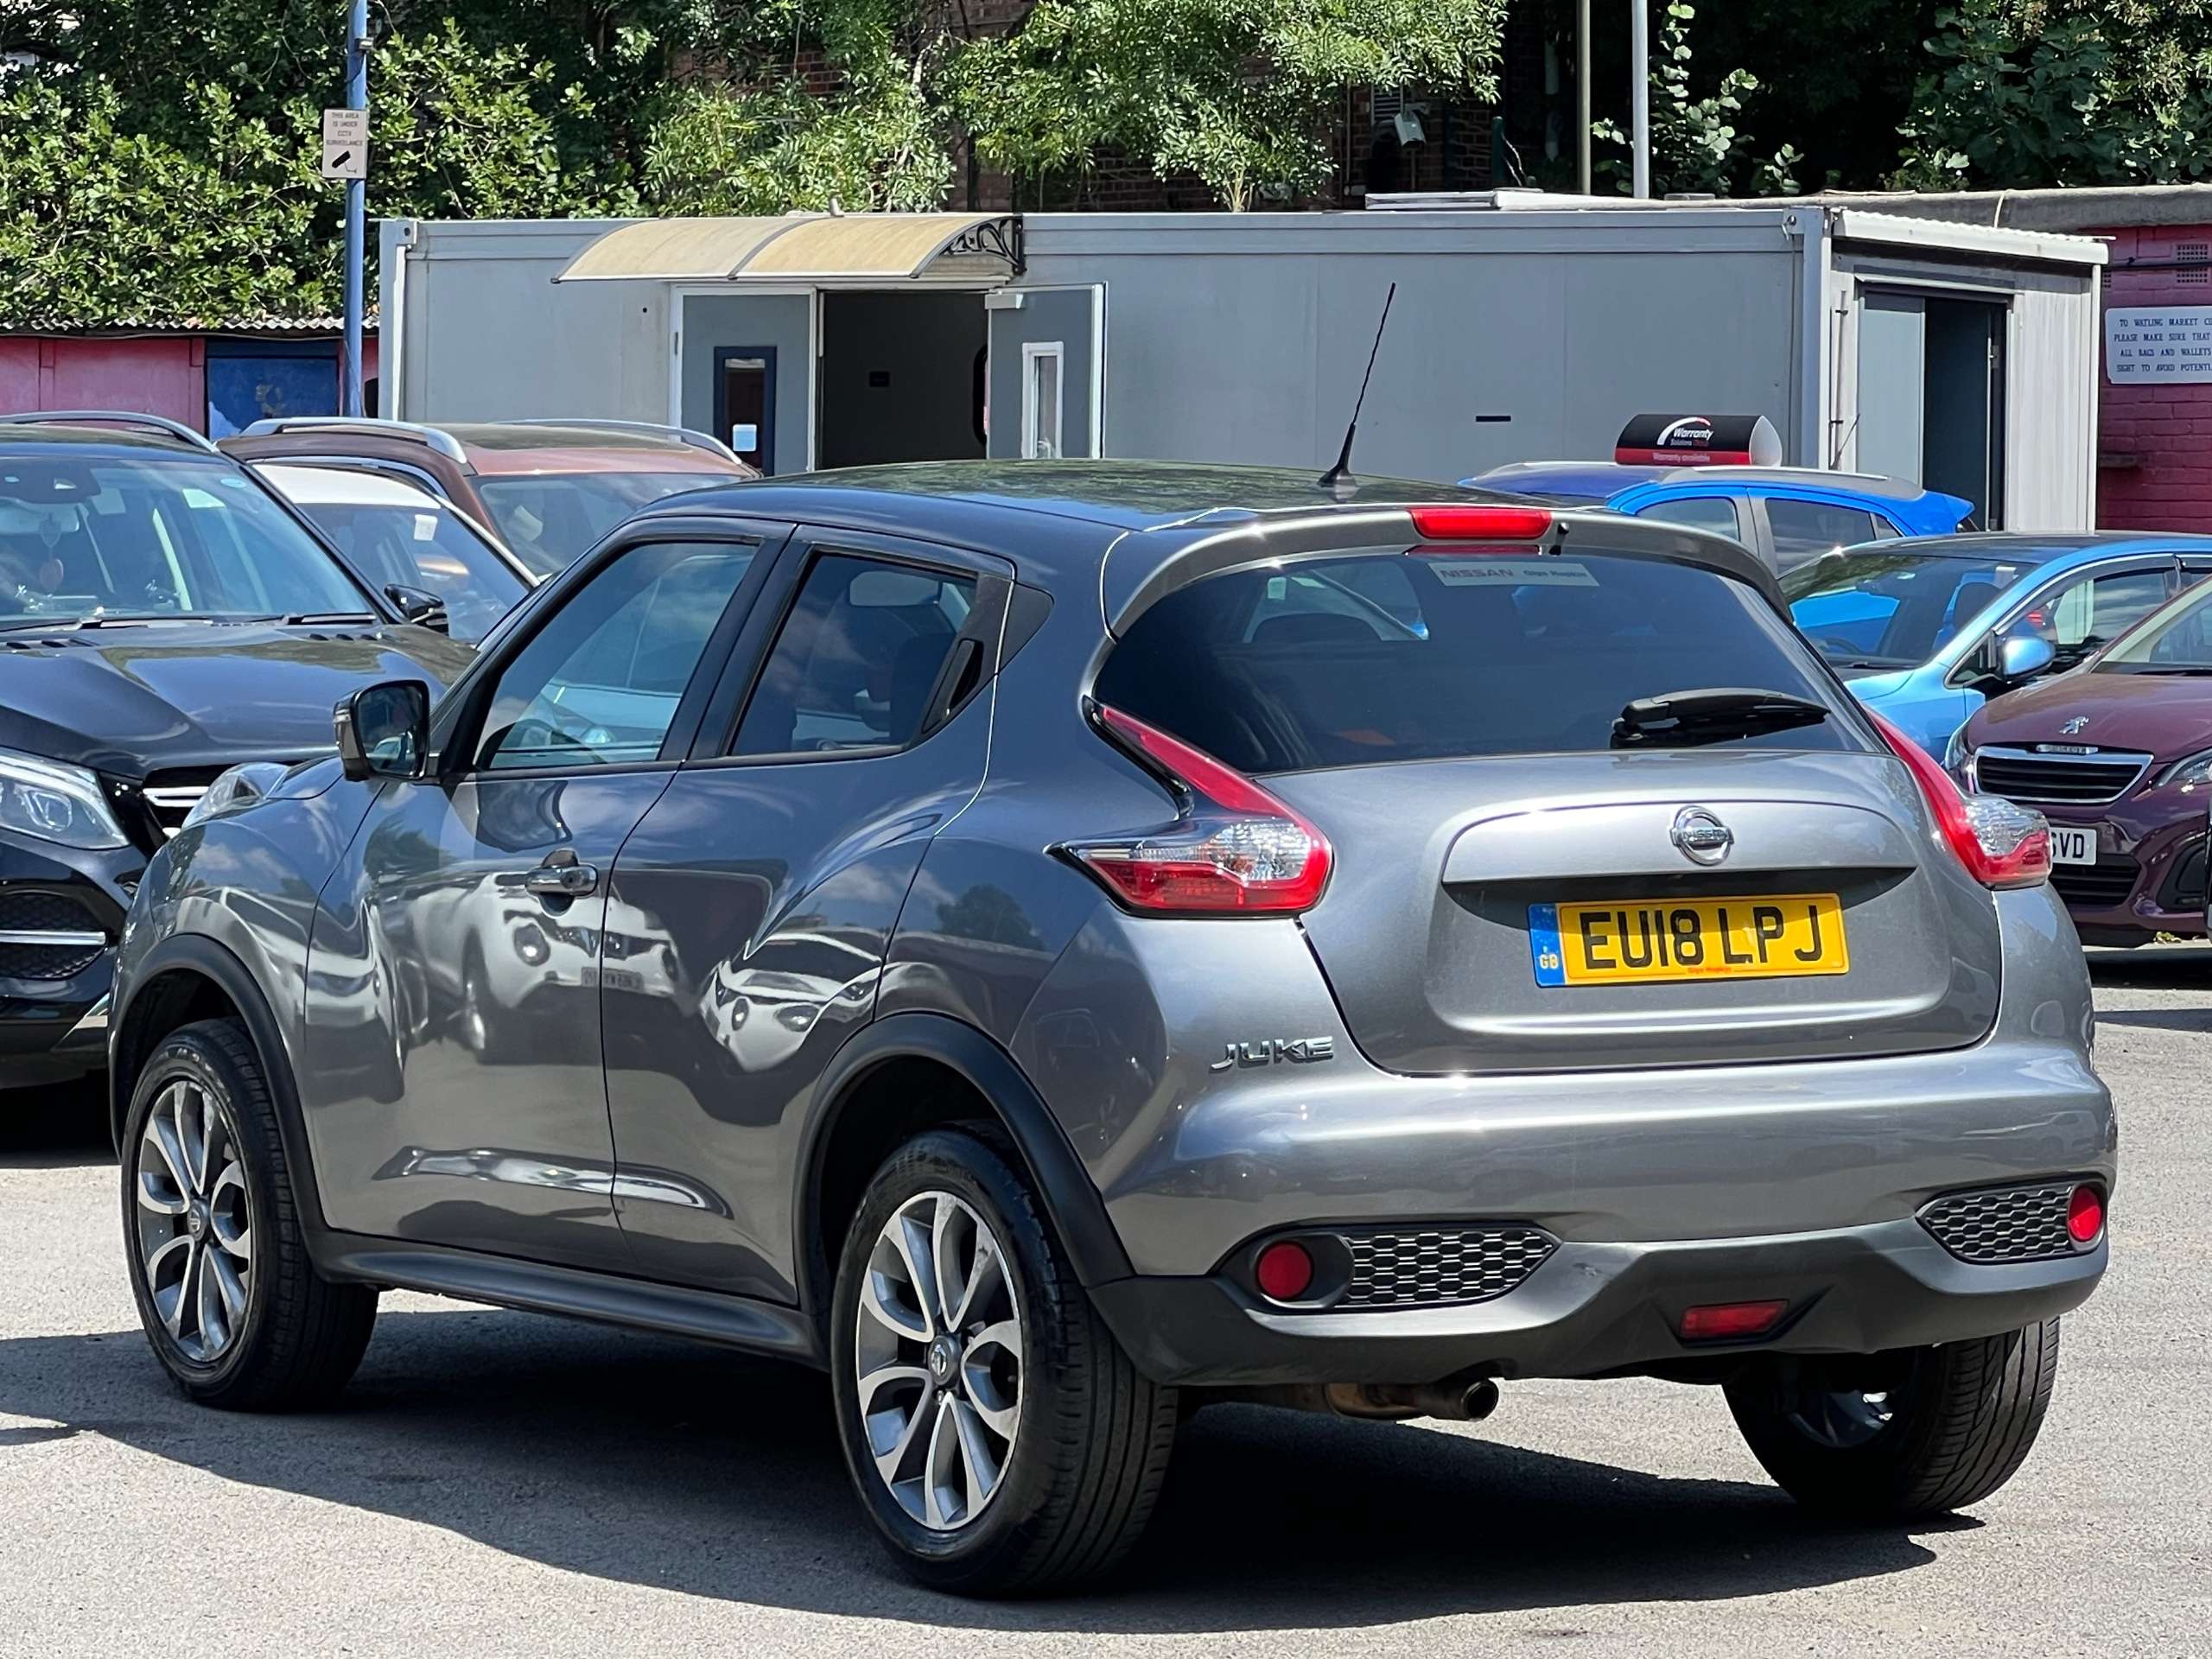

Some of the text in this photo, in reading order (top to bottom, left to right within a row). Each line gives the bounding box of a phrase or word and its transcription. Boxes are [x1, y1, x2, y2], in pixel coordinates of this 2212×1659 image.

[2113, 334, 2138, 342] PLEASE
[2169, 333, 2186, 341] SURE
[1673, 428, 1713, 441] Warranty
[1652, 452, 1681, 463] Warranty
[1440, 569, 1513, 578] NISSAN
[1580, 908, 1704, 970] EU18
[1540, 953, 1559, 969] GB
[1210, 1036, 1334, 1071] JUKE
